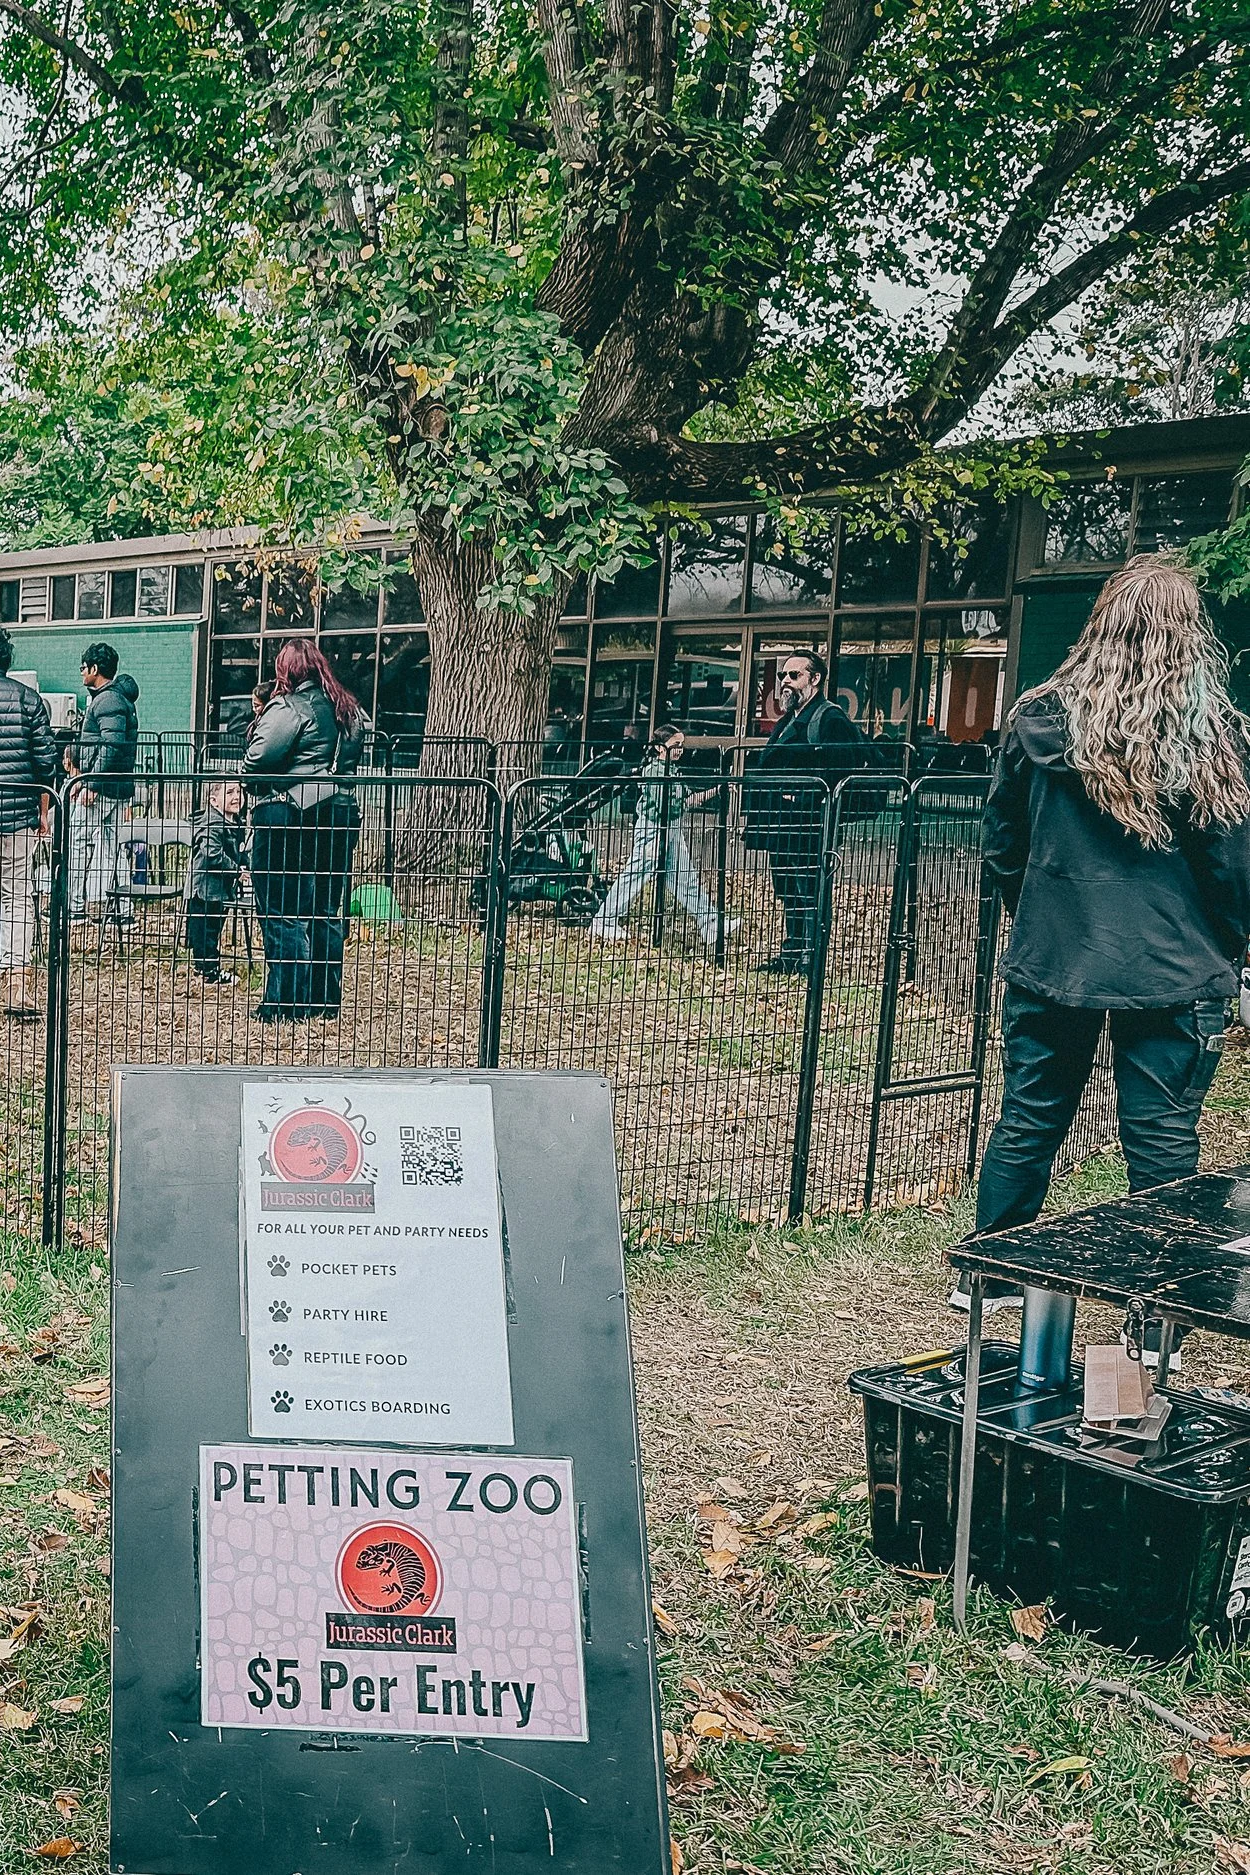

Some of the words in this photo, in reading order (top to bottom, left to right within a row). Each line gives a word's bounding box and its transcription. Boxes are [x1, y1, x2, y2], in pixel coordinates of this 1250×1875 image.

[262, 1189, 328, 1208] Jurassic
[330, 1190, 373, 1209] Clark
[257, 1223, 282, 1234] FOR
[285, 1224, 307, 1235] ALL
[310, 1224, 345, 1236] YOUR
[348, 1225, 371, 1236] PET
[373, 1226, 401, 1237] AND
[404, 1226, 445, 1238] PARTY
[448, 1227, 489, 1239] NEEDS
[301, 1263, 358, 1275] POCKET
[363, 1265, 397, 1276] PETS
[303, 1309, 350, 1320] PARTY
[354, 1310, 388, 1321] HIRE
[304, 1352, 361, 1364] REPTILE
[365, 1354, 408, 1366] FOOD
[305, 1399, 367, 1412] EXOTICS
[371, 1401, 451, 1415] BOARDING
[213, 1461, 421, 1510] PETTING
[445, 1471, 562, 1516] ZOO
[329, 1622, 402, 1646] Jurassic
[405, 1624, 454, 1647] Clark
[247, 1652, 301, 1715] $5
[320, 1660, 398, 1713] Per
[415, 1664, 536, 1728] Entry
